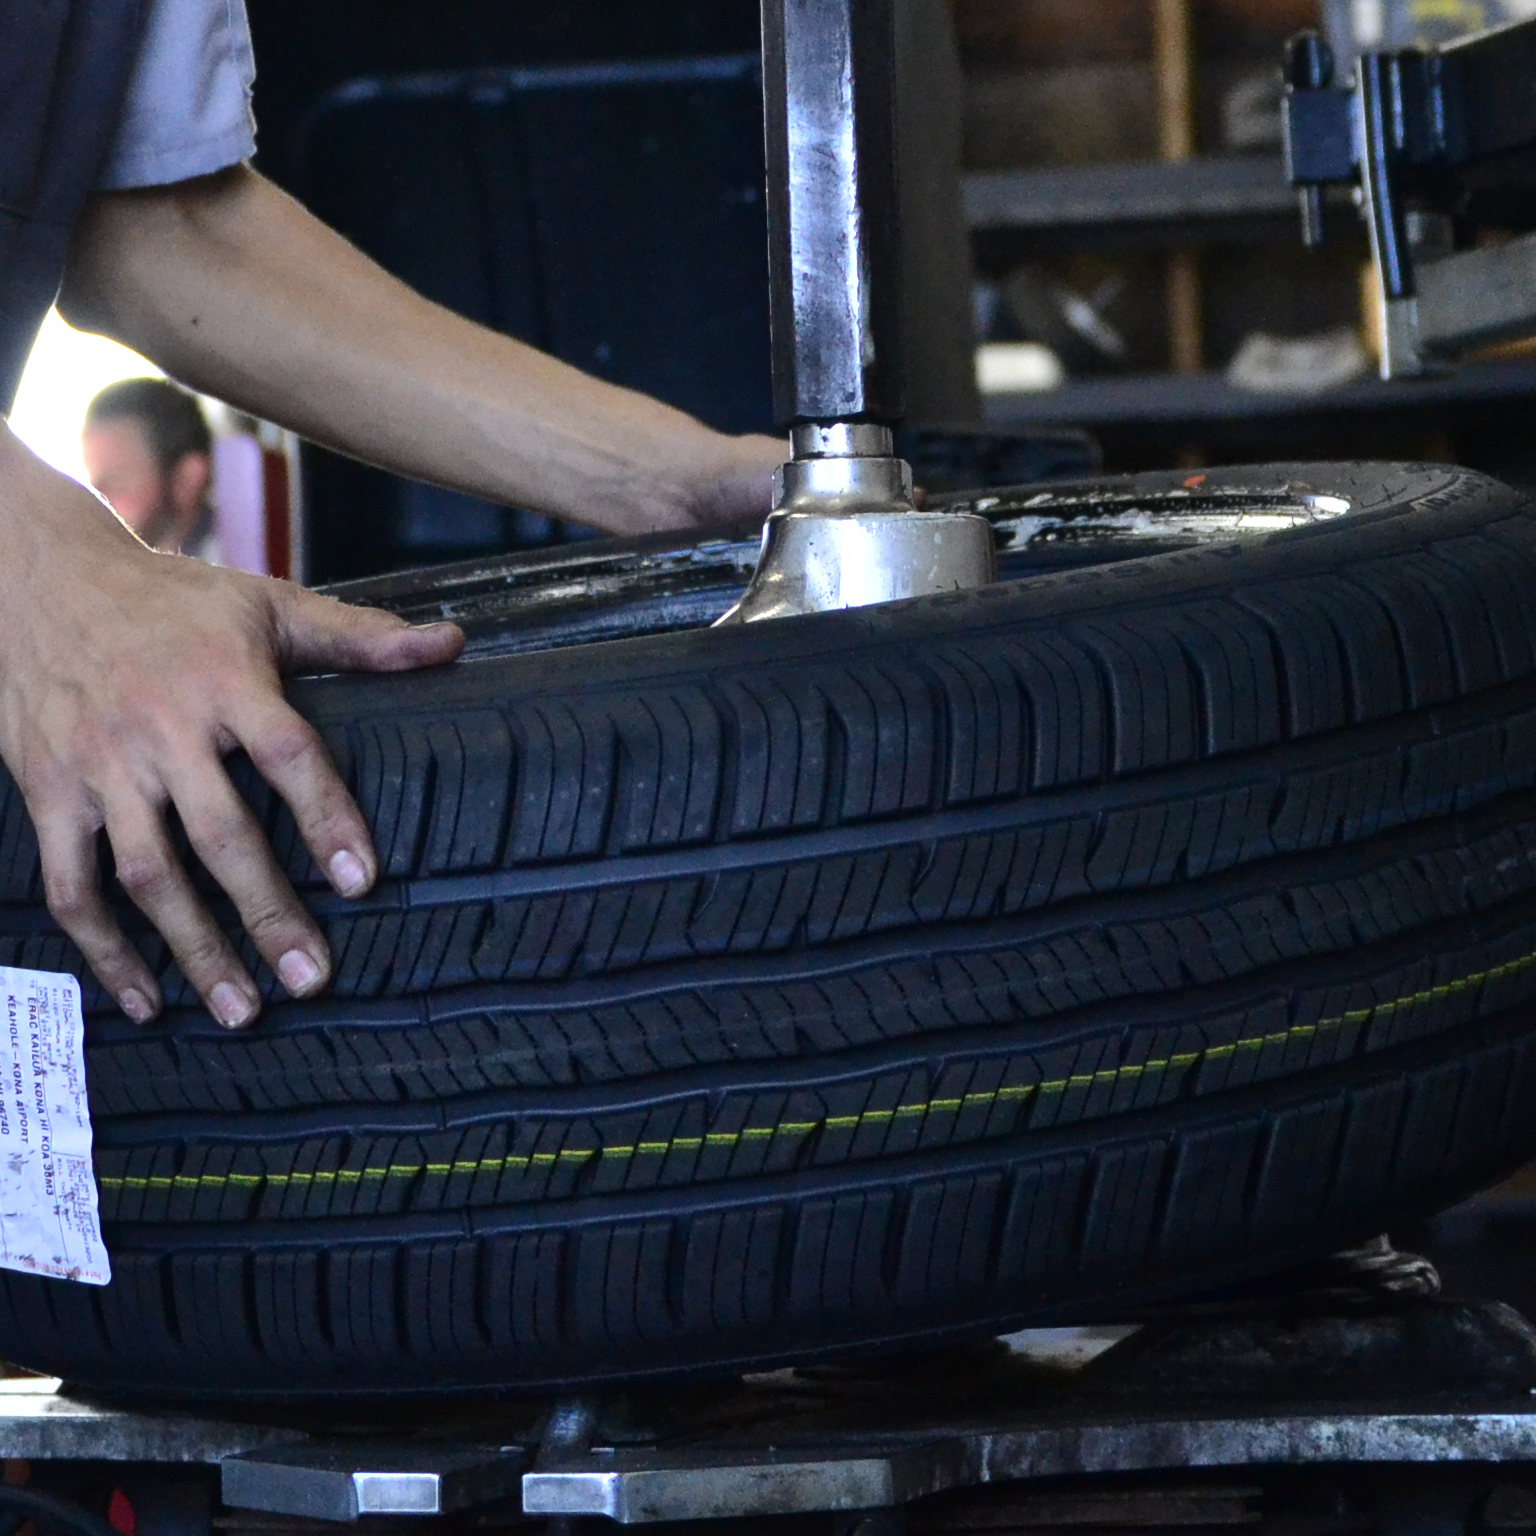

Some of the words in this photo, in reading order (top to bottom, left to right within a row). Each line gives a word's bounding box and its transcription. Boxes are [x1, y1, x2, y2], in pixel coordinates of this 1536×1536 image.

[27, 997, 38, 1029] ERAC
[31, 1034, 43, 1077] KAILUA
[34, 1082, 45, 1114] KONA
[16, 1100, 28, 1144] AIPORT
[40, 1119, 49, 1131] HI
[41, 1136, 50, 1159] KOA
